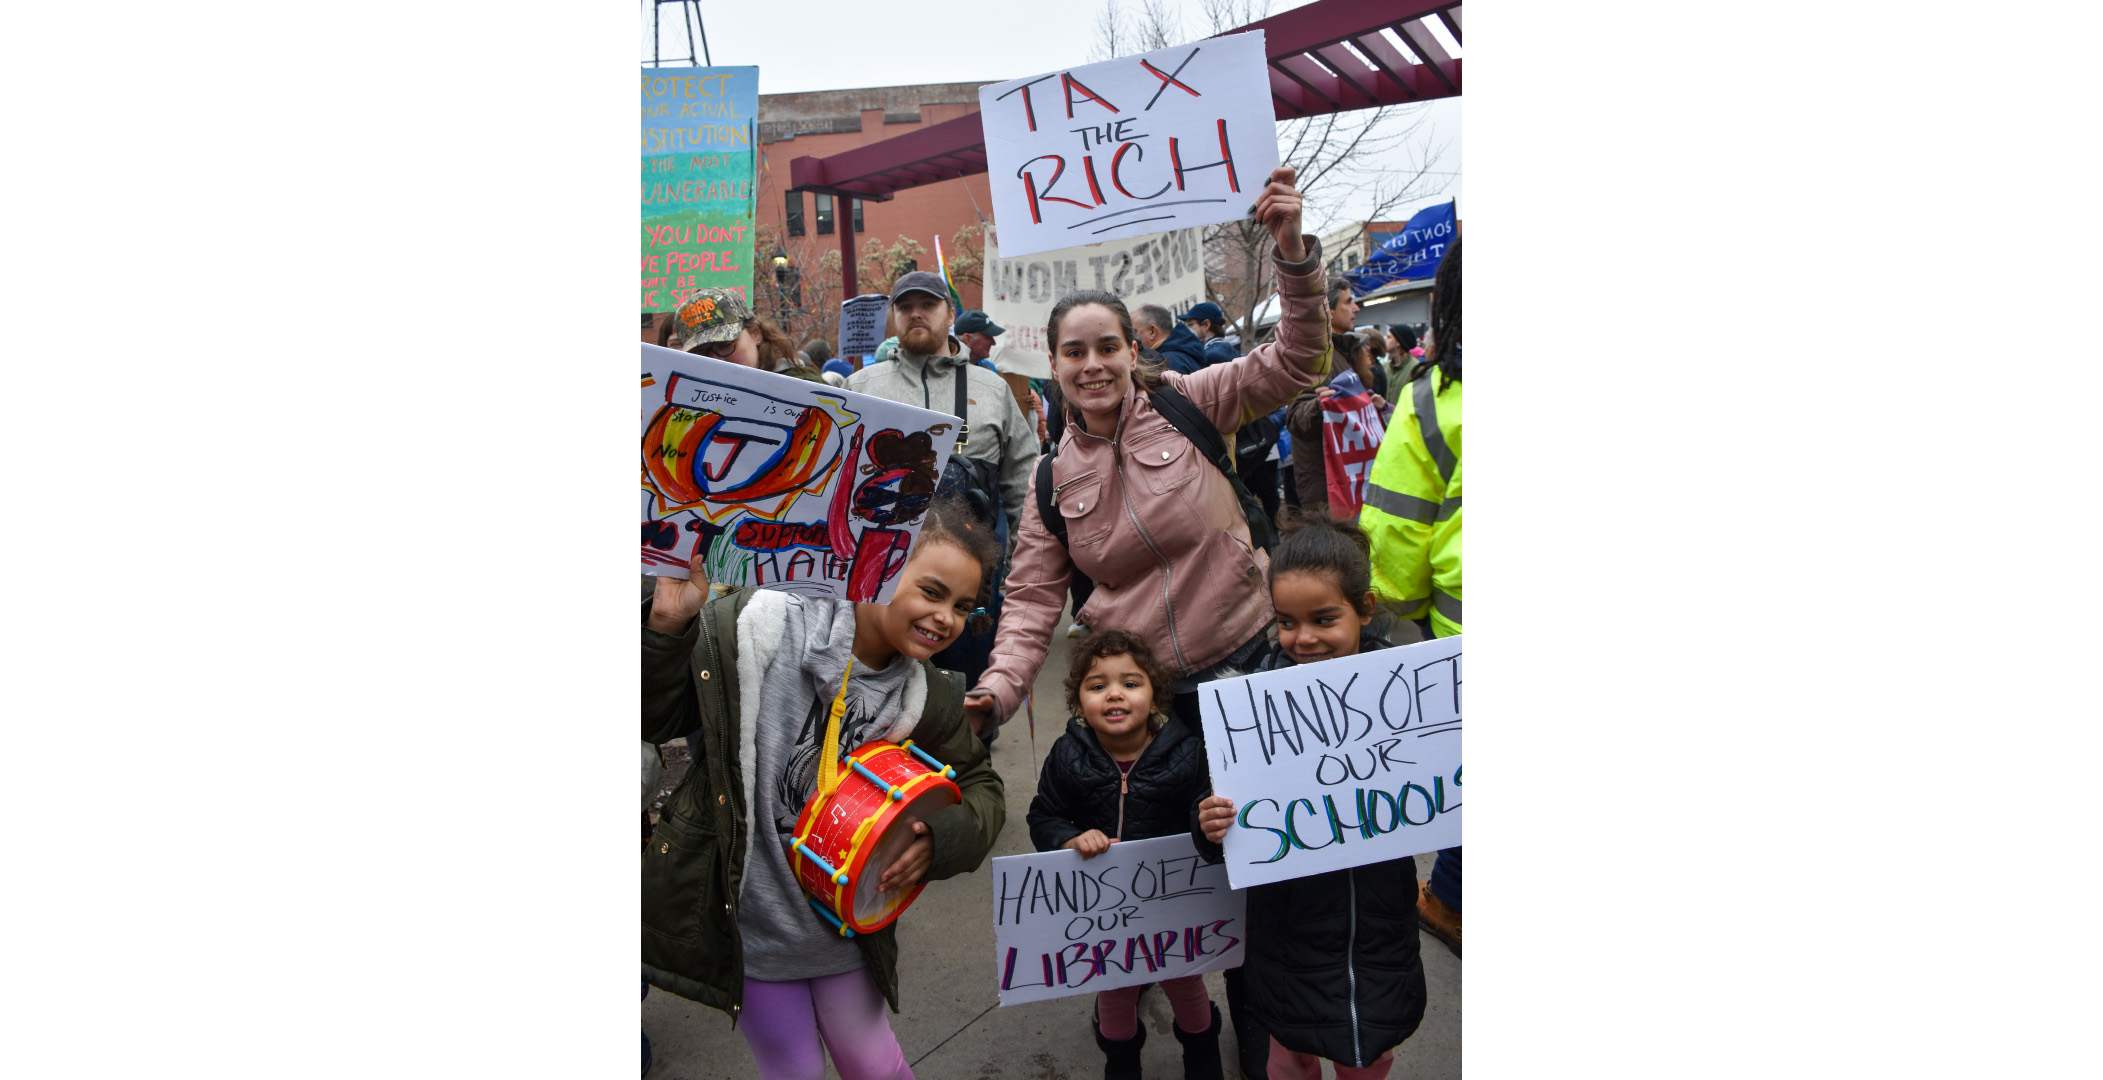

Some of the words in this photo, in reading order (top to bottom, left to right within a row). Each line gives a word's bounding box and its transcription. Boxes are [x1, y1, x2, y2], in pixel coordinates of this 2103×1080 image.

[641, 75, 733, 101] ROTECT
[996, 47, 1201, 132] TAX
[679, 101, 744, 119] ACTUAL
[641, 125, 747, 152] NSTITUTION
[1070, 117, 1149, 151] THE
[649, 156, 676, 173] THE
[690, 155, 731, 171] MOST
[1017, 118, 1241, 225] RICH
[641, 179, 750, 204] ULNERABLE
[645, 223, 690, 248] YOU
[641, 253, 660, 273] VE
[666, 251, 739, 275] PEOPLE,
[677, 275, 697, 288] BE
[680, 298, 716, 324] HARRIS
[686, 312, 713, 329] WALZ
[763, 400, 777, 415] is
[1214, 672, 1373, 766] HANDS
[1316, 738, 1417, 786] OUR
[999, 866, 1127, 926] HANDS
[1132, 855, 1225, 899] OFF
[1065, 905, 1144, 940] OUR
[1001, 918, 1240, 991] LIBRARIES
